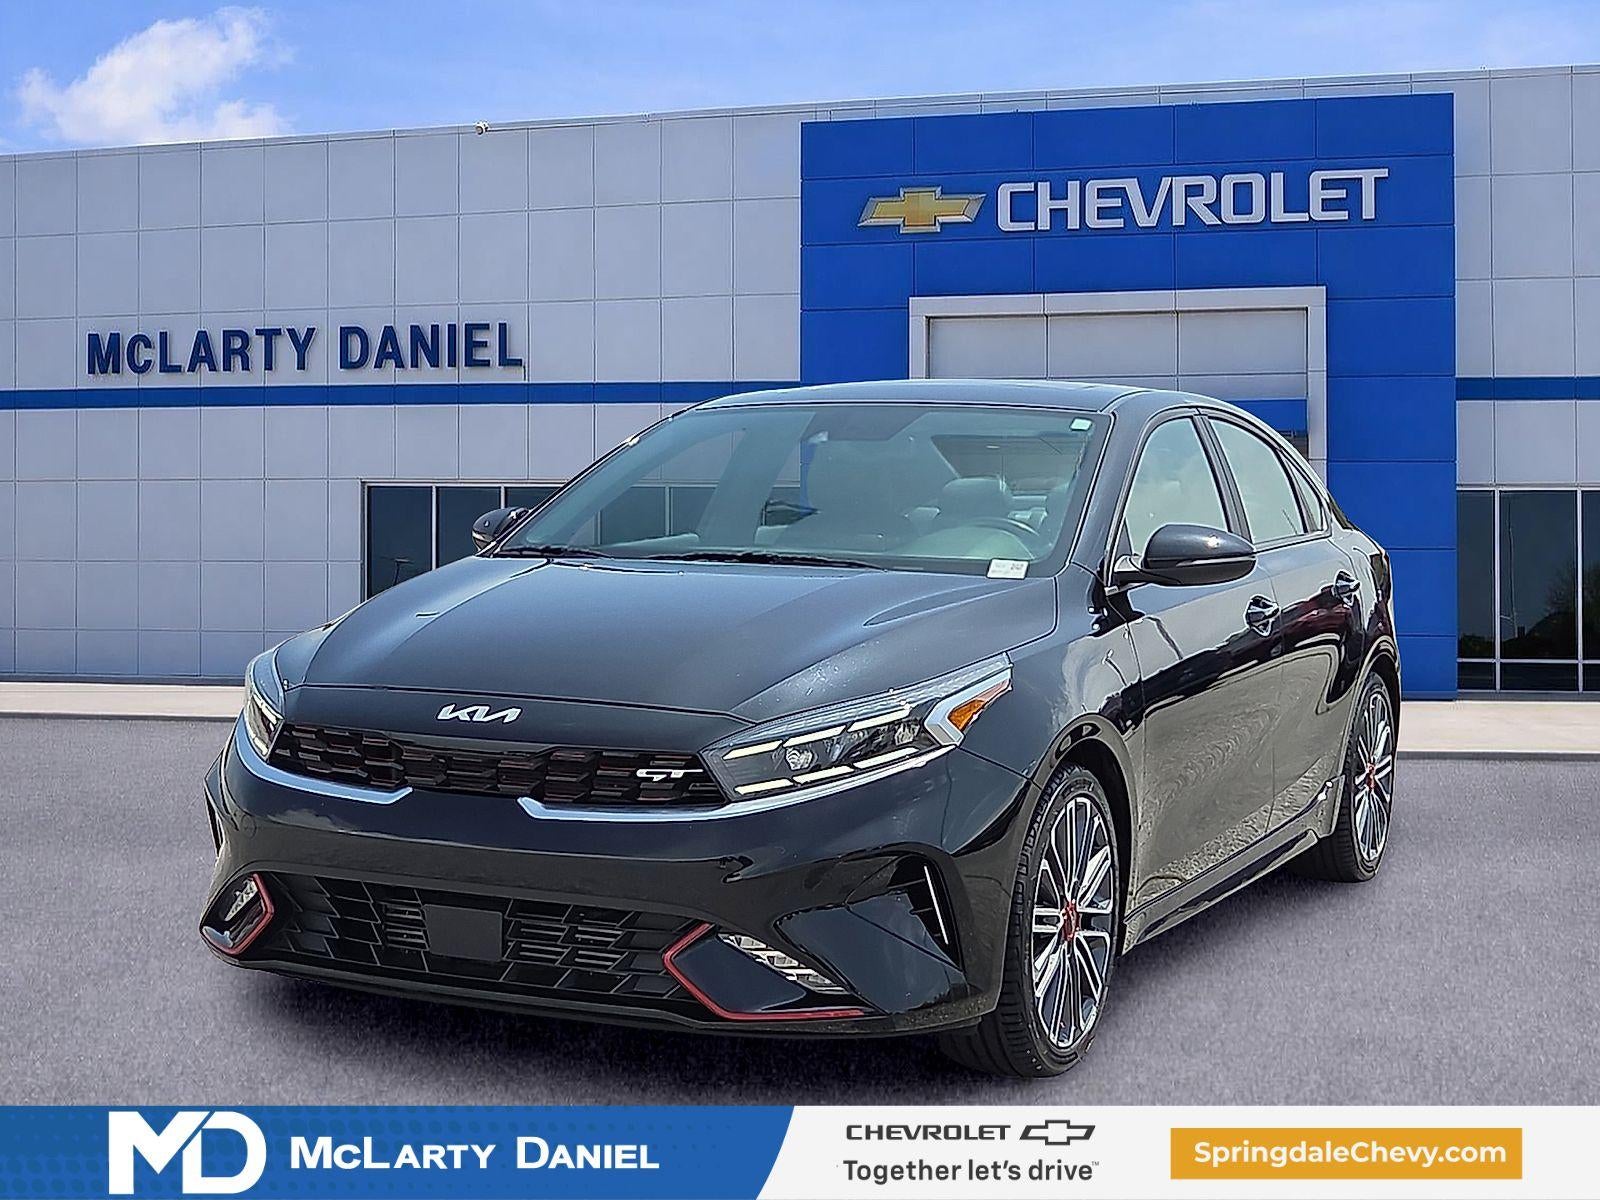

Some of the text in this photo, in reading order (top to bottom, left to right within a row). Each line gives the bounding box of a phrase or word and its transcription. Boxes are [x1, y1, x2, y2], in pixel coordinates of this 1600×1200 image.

[997, 168, 1389, 232] CHEVROLET
[339, 322, 523, 370] DANIEL
[437, 704, 522, 723] KIA
[636, 768, 703, 781] GT
